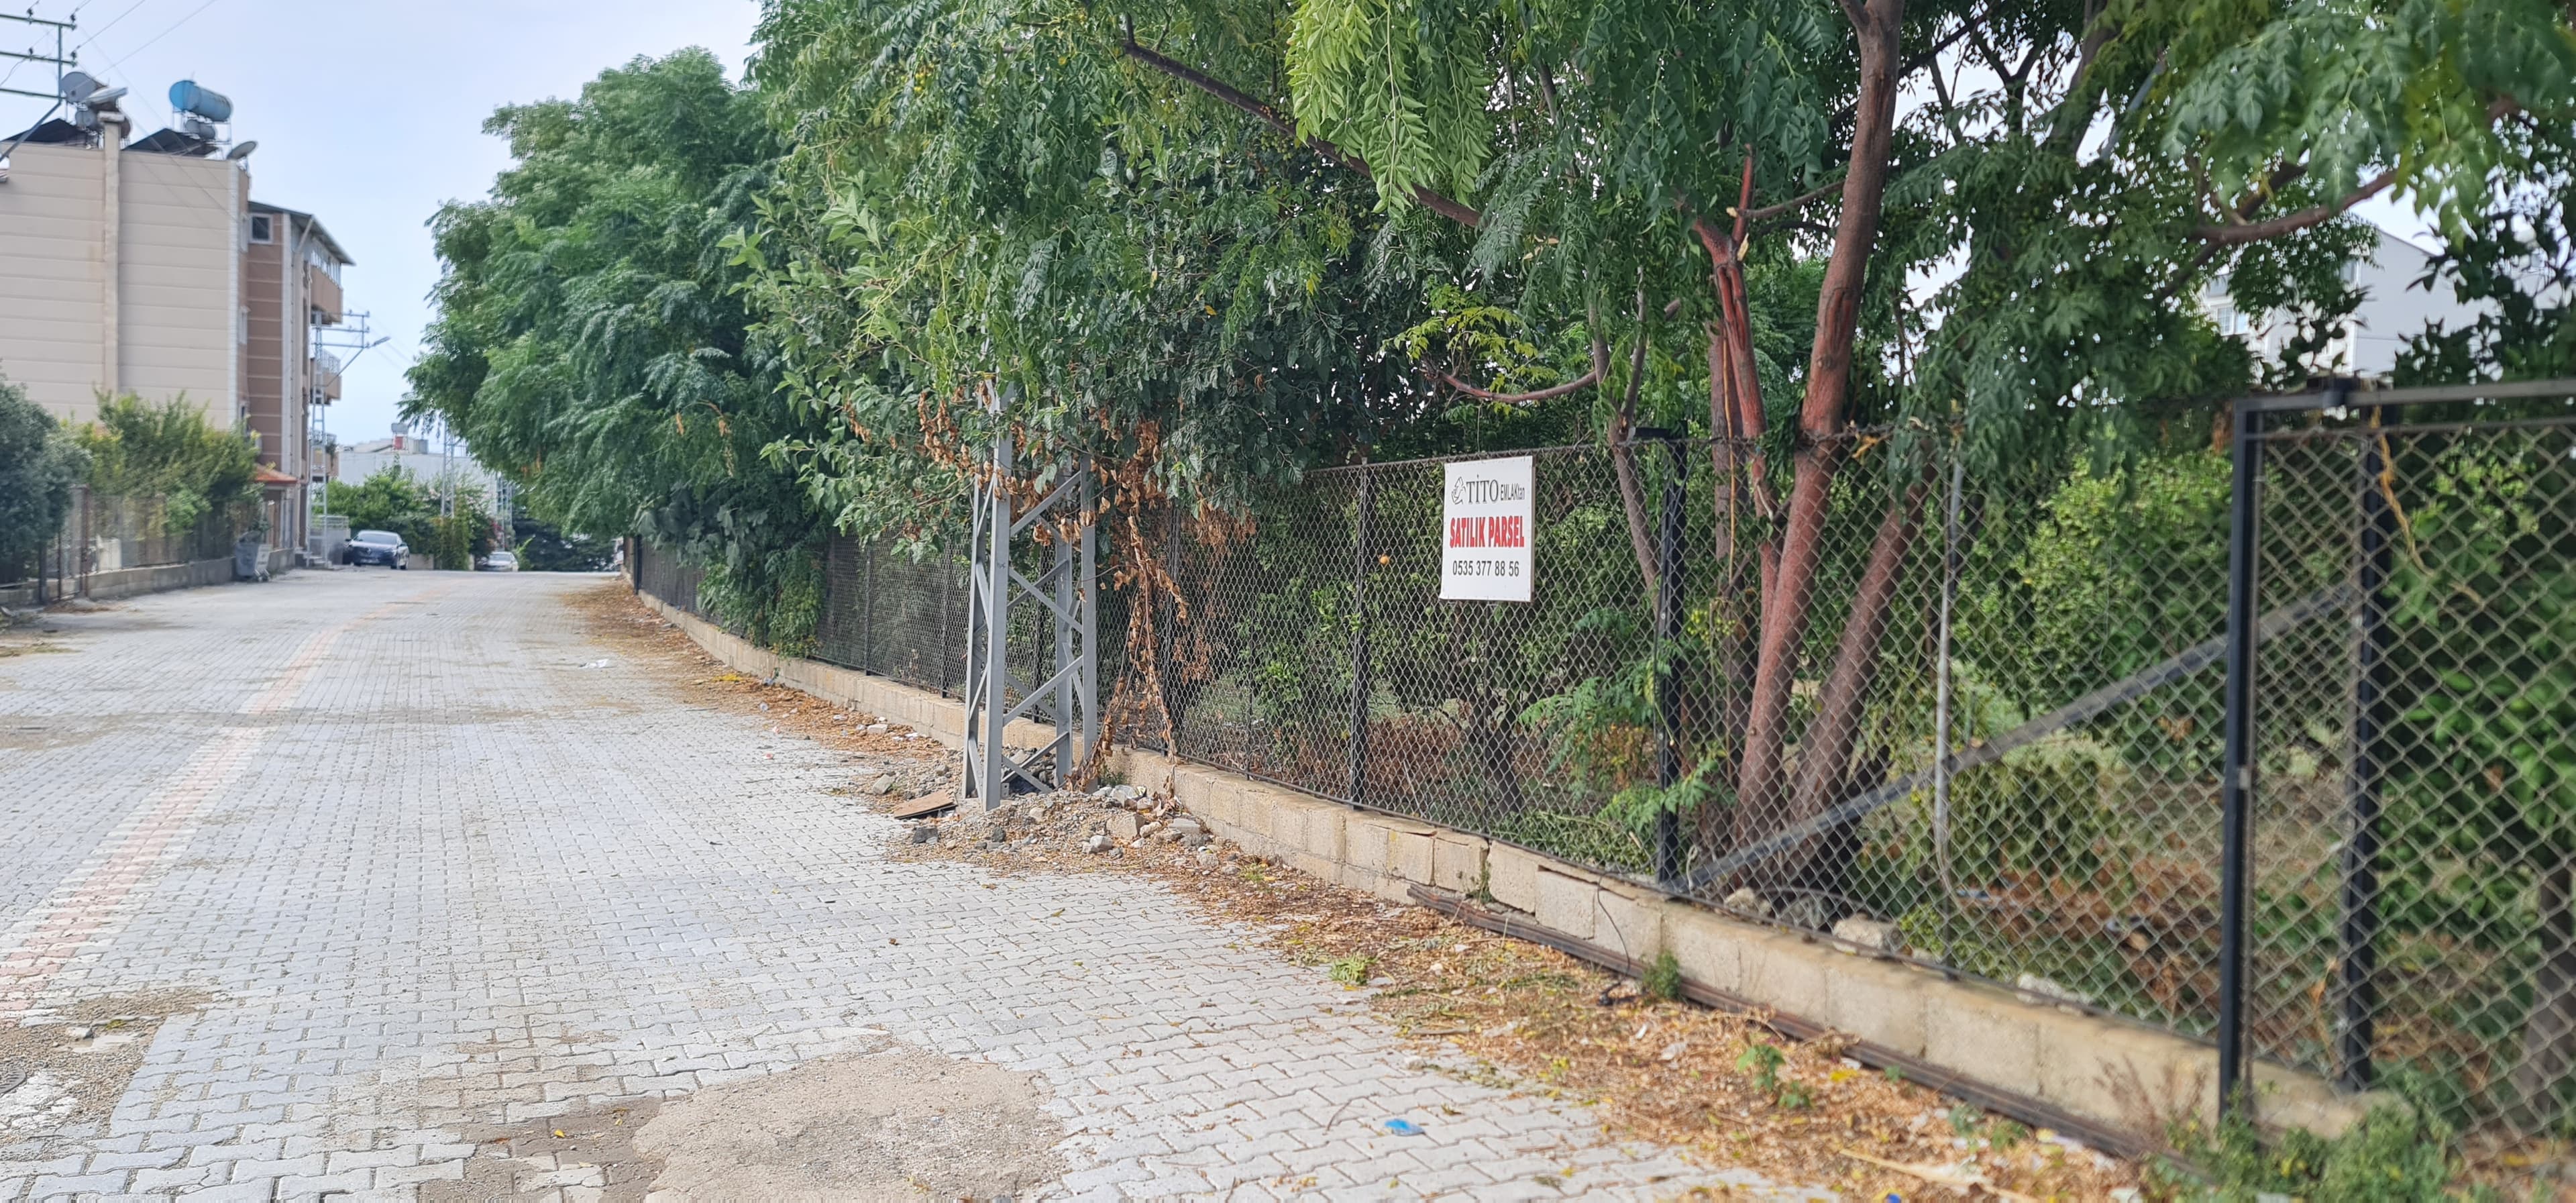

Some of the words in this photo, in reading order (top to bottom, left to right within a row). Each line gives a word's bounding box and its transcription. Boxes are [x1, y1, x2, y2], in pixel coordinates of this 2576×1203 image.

[1466, 474, 1499, 503] TİTO
[1450, 517, 1486, 548] SATILIK
[1488, 515, 1524, 547] PARSEL
[1452, 560, 1473, 576] 0535
[1476, 560, 1492, 576] 377
[1495, 560, 1505, 576] 88
[1509, 561, 1519, 576] 56
